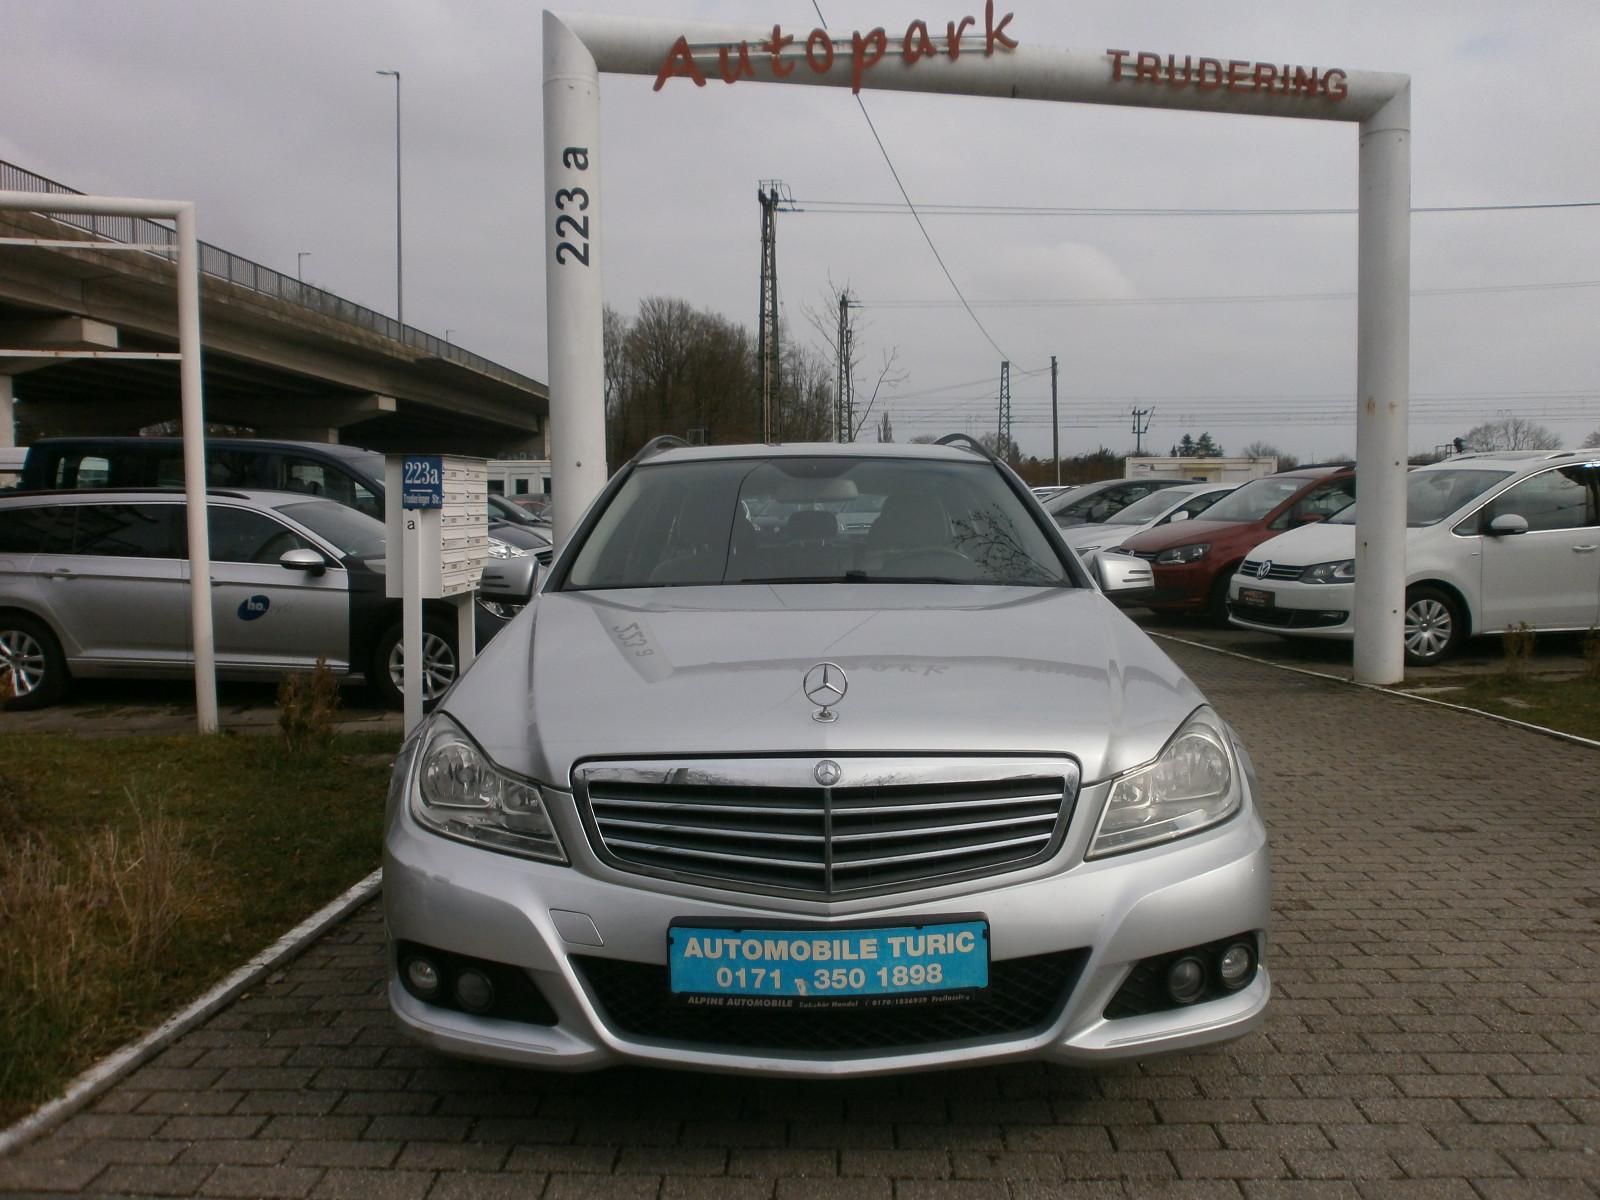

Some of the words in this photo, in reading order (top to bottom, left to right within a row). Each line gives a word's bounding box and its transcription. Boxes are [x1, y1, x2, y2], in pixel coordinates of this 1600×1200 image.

[653, 0, 1019, 94] Autopark
[1106, 48, 1348, 101] TRUDERING
[562, 146, 589, 171] a
[555, 187, 589, 267] 223
[405, 461, 439, 485] 223a
[407, 520, 415, 530] a
[684, 936, 878, 961] AUTOMOBILE
[887, 931, 975, 958] TURIC
[716, 967, 781, 990] 0171
[814, 967, 865, 990] 350
[877, 963, 943, 988] 1898
[688, 996, 724, 1006] ALPINE
[726, 998, 793, 1008] AUTOMOBILE
